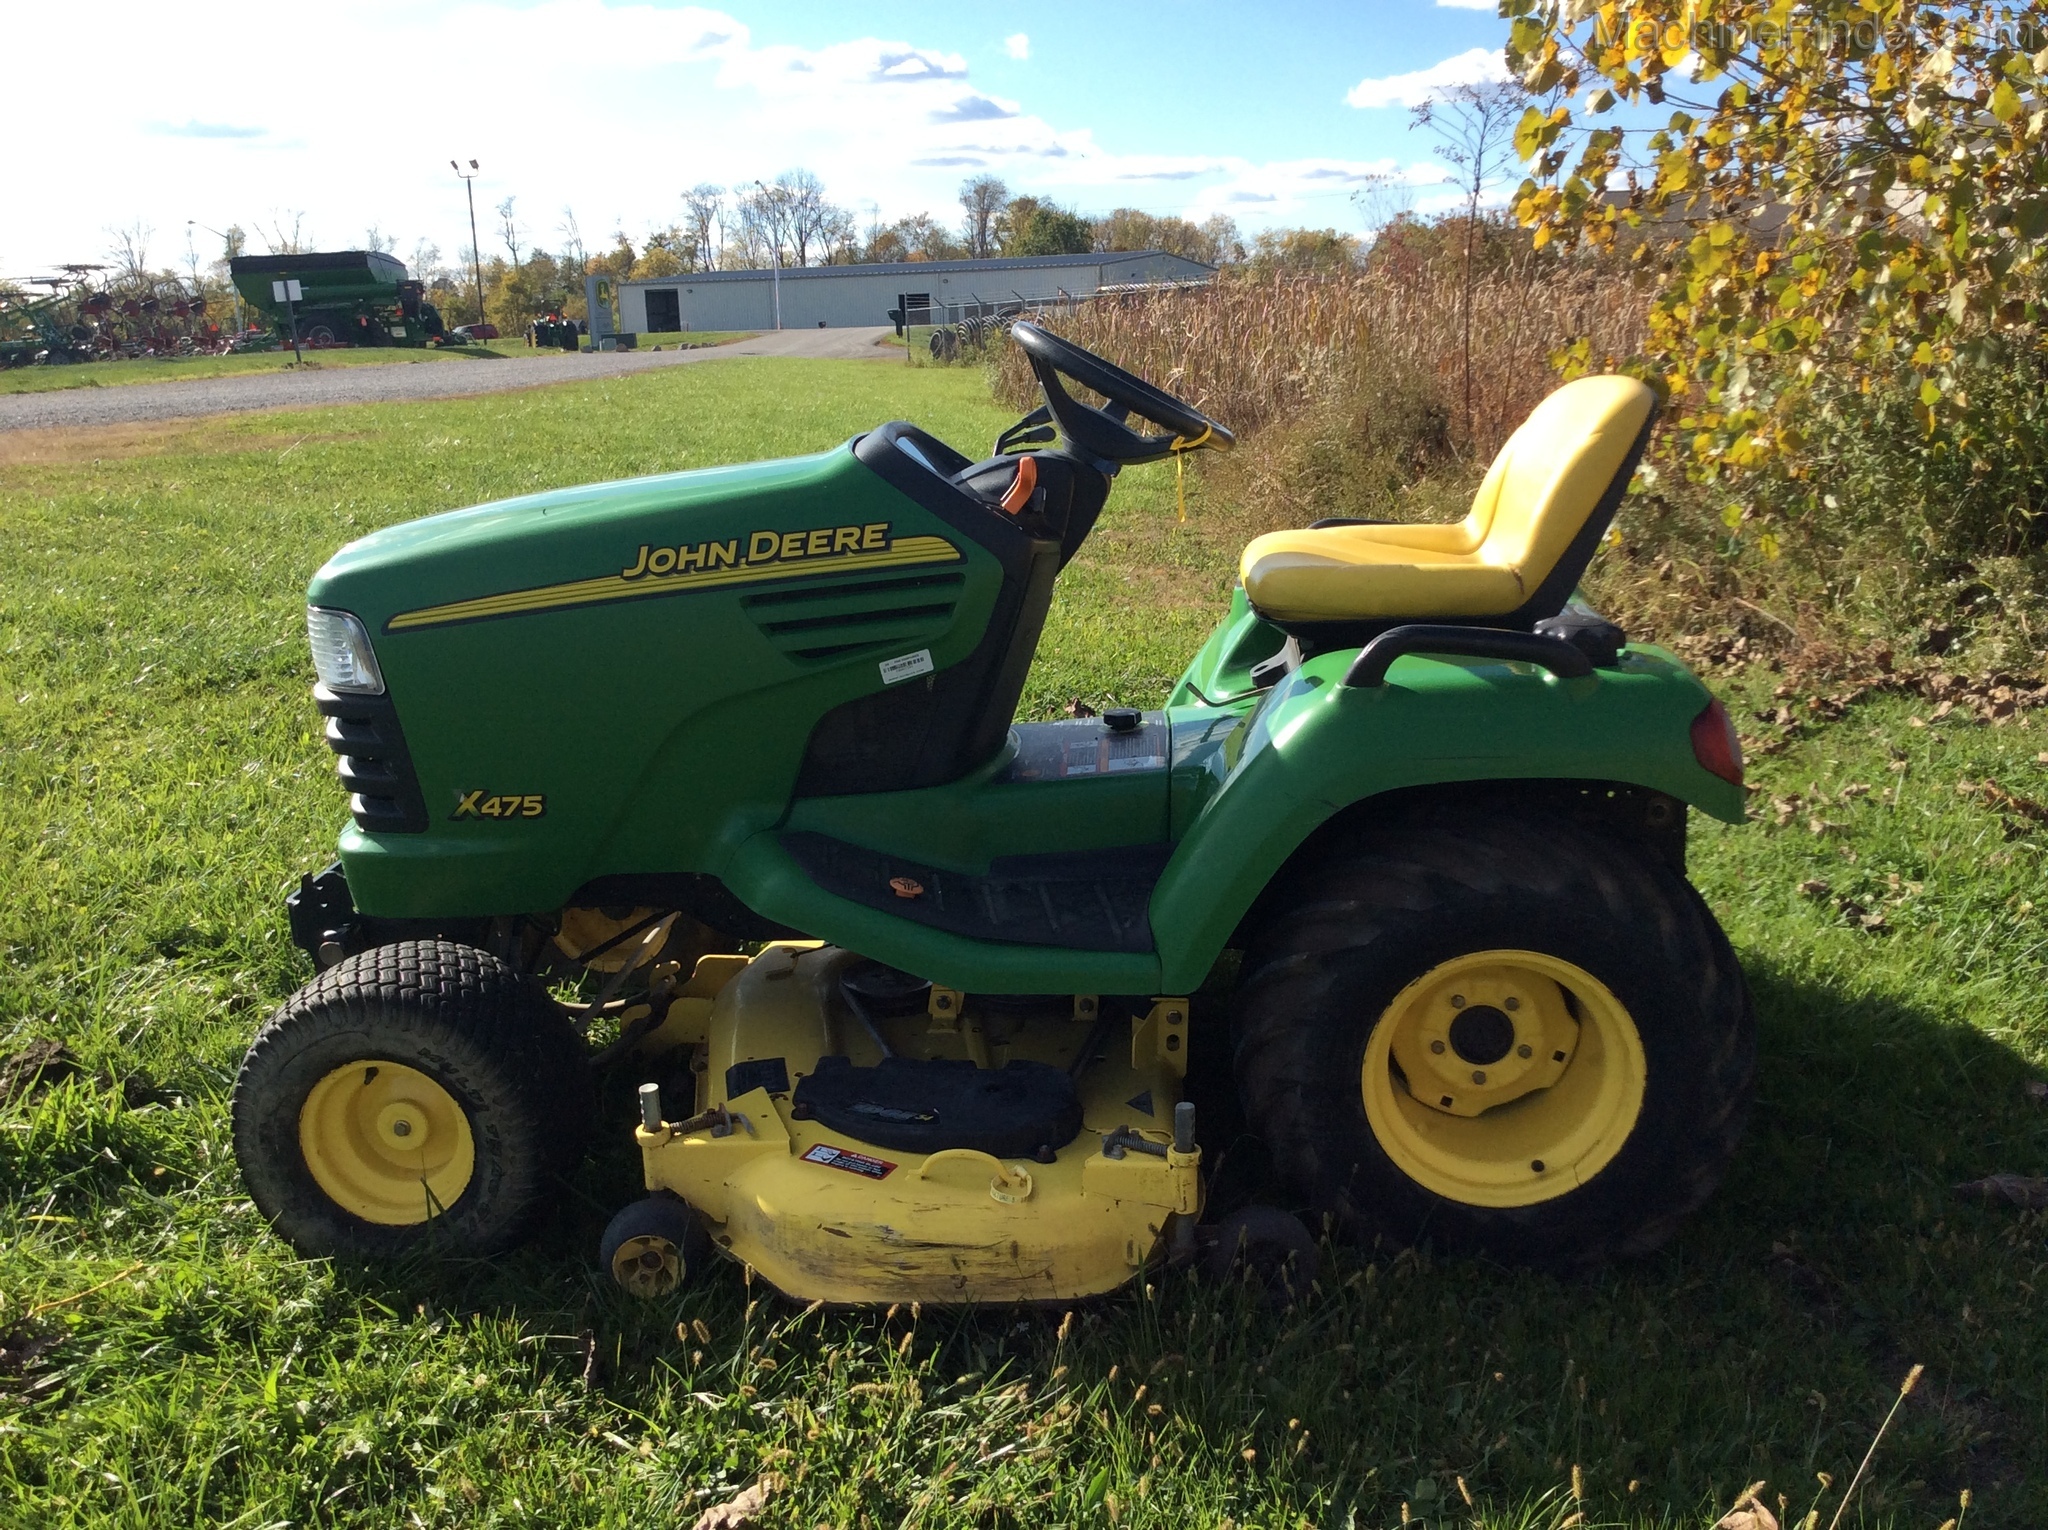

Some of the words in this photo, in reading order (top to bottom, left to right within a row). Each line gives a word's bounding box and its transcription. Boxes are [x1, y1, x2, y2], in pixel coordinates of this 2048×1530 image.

[622, 540, 739, 578] JOHN
[748, 523, 890, 563] DEERE
[451, 790, 543, 818] X475
